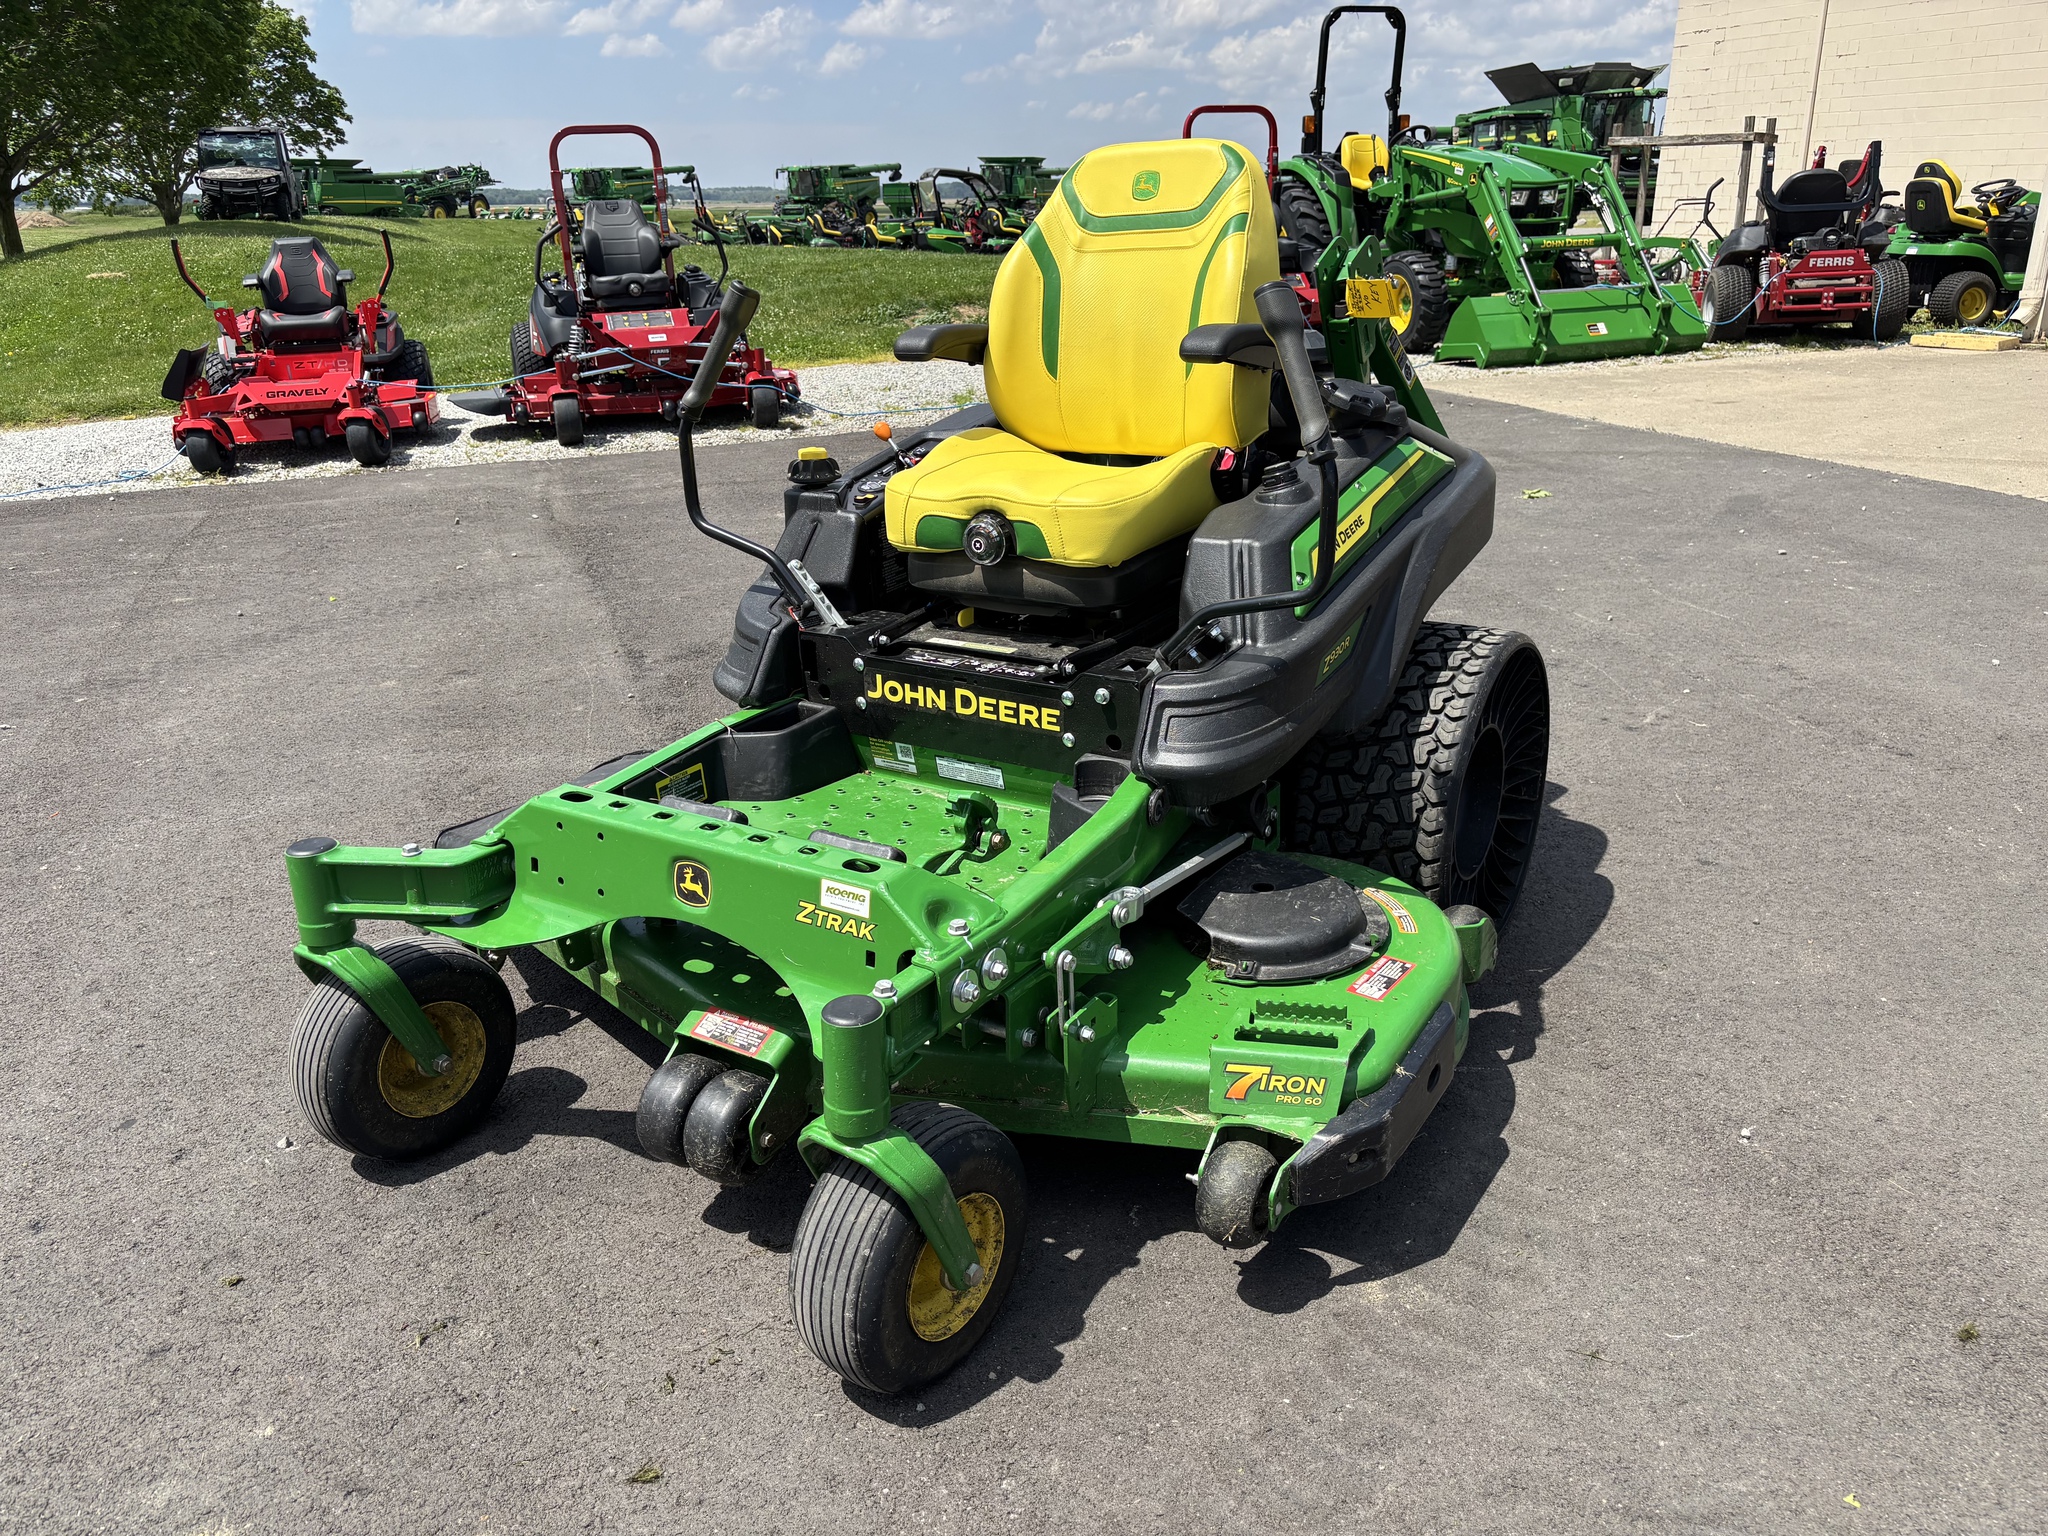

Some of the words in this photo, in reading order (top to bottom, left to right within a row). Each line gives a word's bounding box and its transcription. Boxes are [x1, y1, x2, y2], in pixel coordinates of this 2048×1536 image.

[1541, 239, 1564, 248] JOHN
[1566, 238, 1595, 247] DEERE
[1808, 256, 1855, 268] FERRIS
[1366, 281, 1382, 304] KEY
[266, 387, 329, 399] GRAVELY
[1338, 514, 1365, 545] DEERE
[1322, 635, 1351, 674] Z930R
[867, 673, 946, 711] JOHN
[954, 687, 1061, 732] DEERE
[795, 900, 878, 942] ZTRAK
[1275, 1094, 1301, 1104] PRO
[1304, 1097, 1322, 1105] 60
